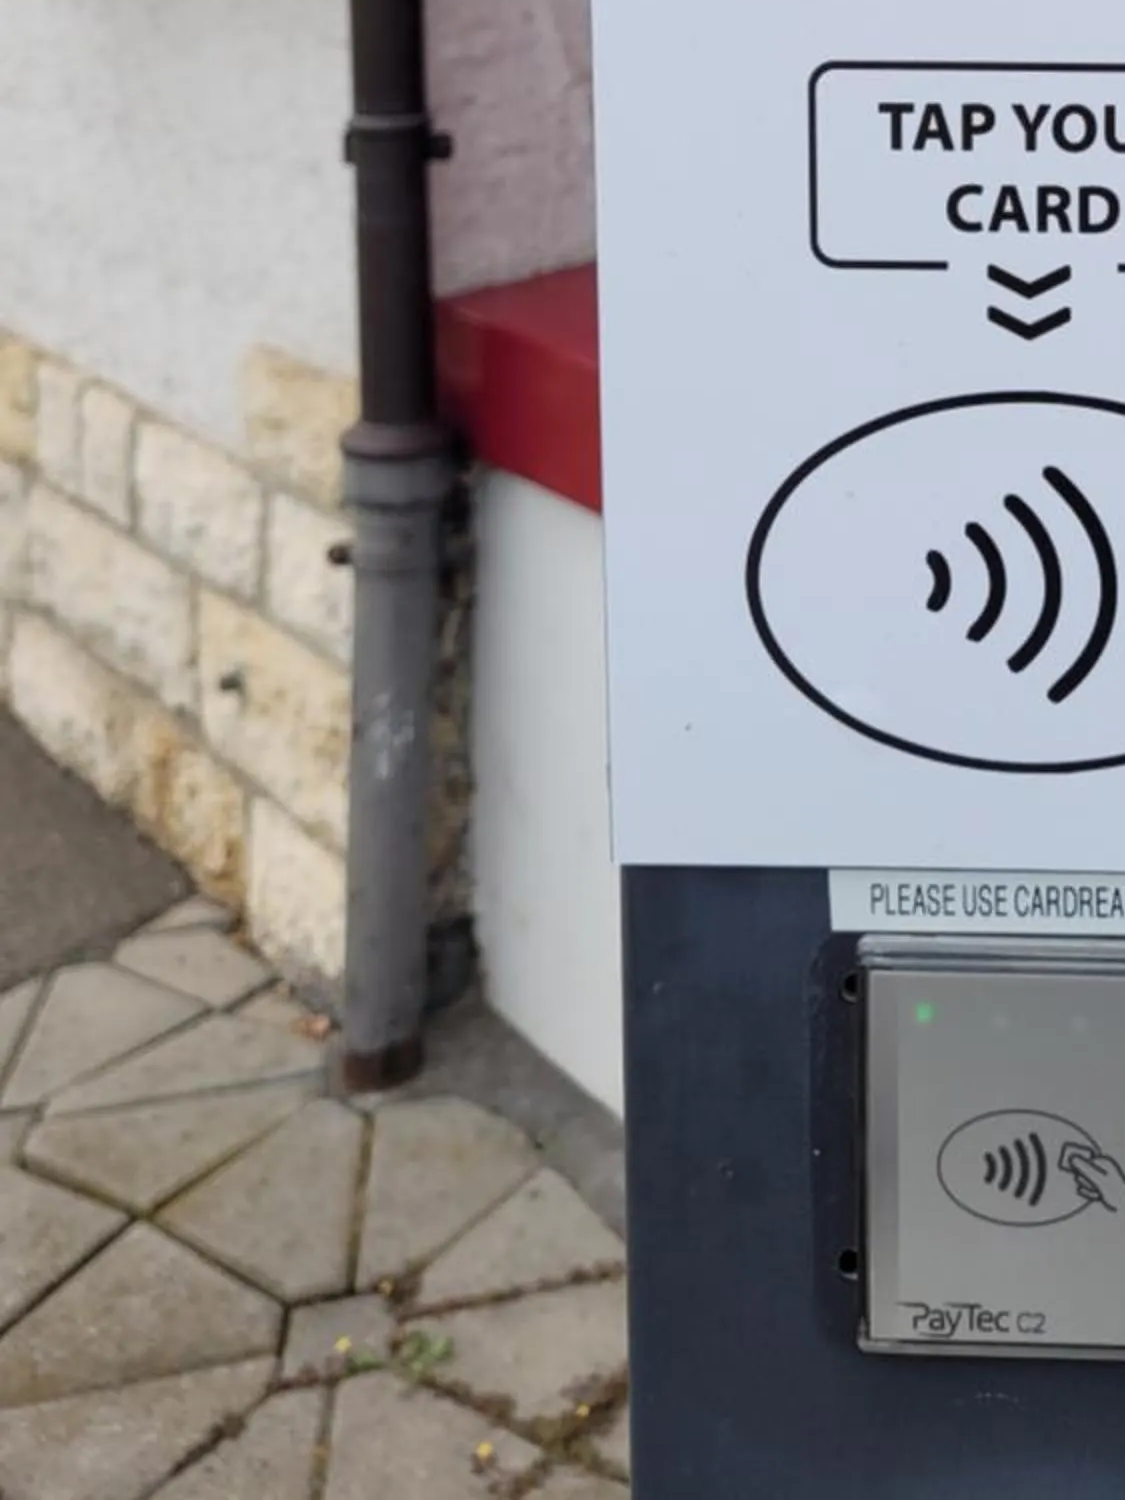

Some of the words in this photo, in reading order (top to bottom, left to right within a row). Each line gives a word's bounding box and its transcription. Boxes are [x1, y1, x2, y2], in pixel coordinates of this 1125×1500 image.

[878, 102, 996, 152] TAP
[946, 184, 1121, 234] CARD
[870, 882, 956, 917] PLEASE
[962, 883, 1008, 918] USE
[896, 1301, 1010, 1338] PayTec
[1015, 1310, 1047, 1335] C2
